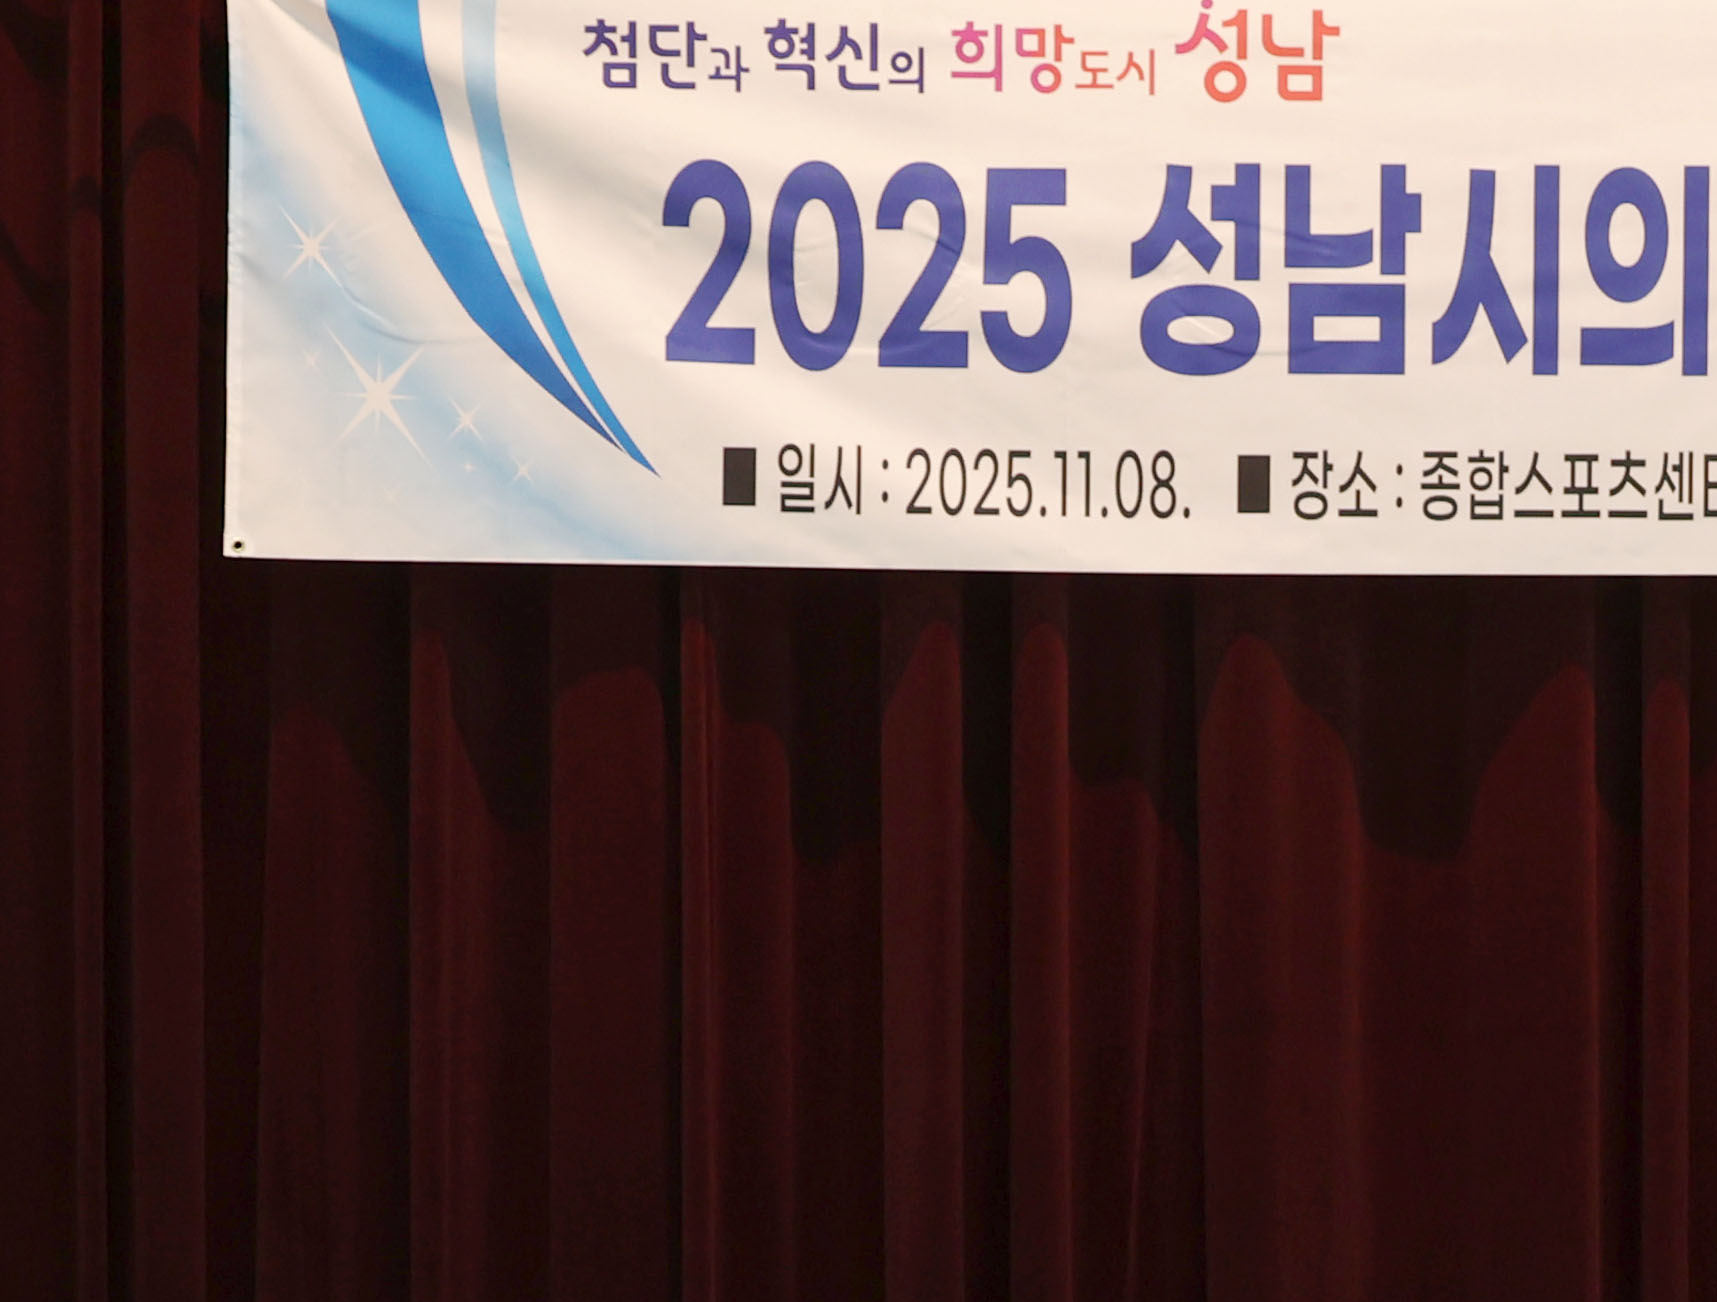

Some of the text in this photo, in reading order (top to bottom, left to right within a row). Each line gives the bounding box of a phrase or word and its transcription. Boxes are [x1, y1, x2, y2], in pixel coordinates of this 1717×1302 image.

[583, 8, 1340, 103] 첨단과 혁신의 희망도시 성남
[662, 160, 1072, 373] 2025
